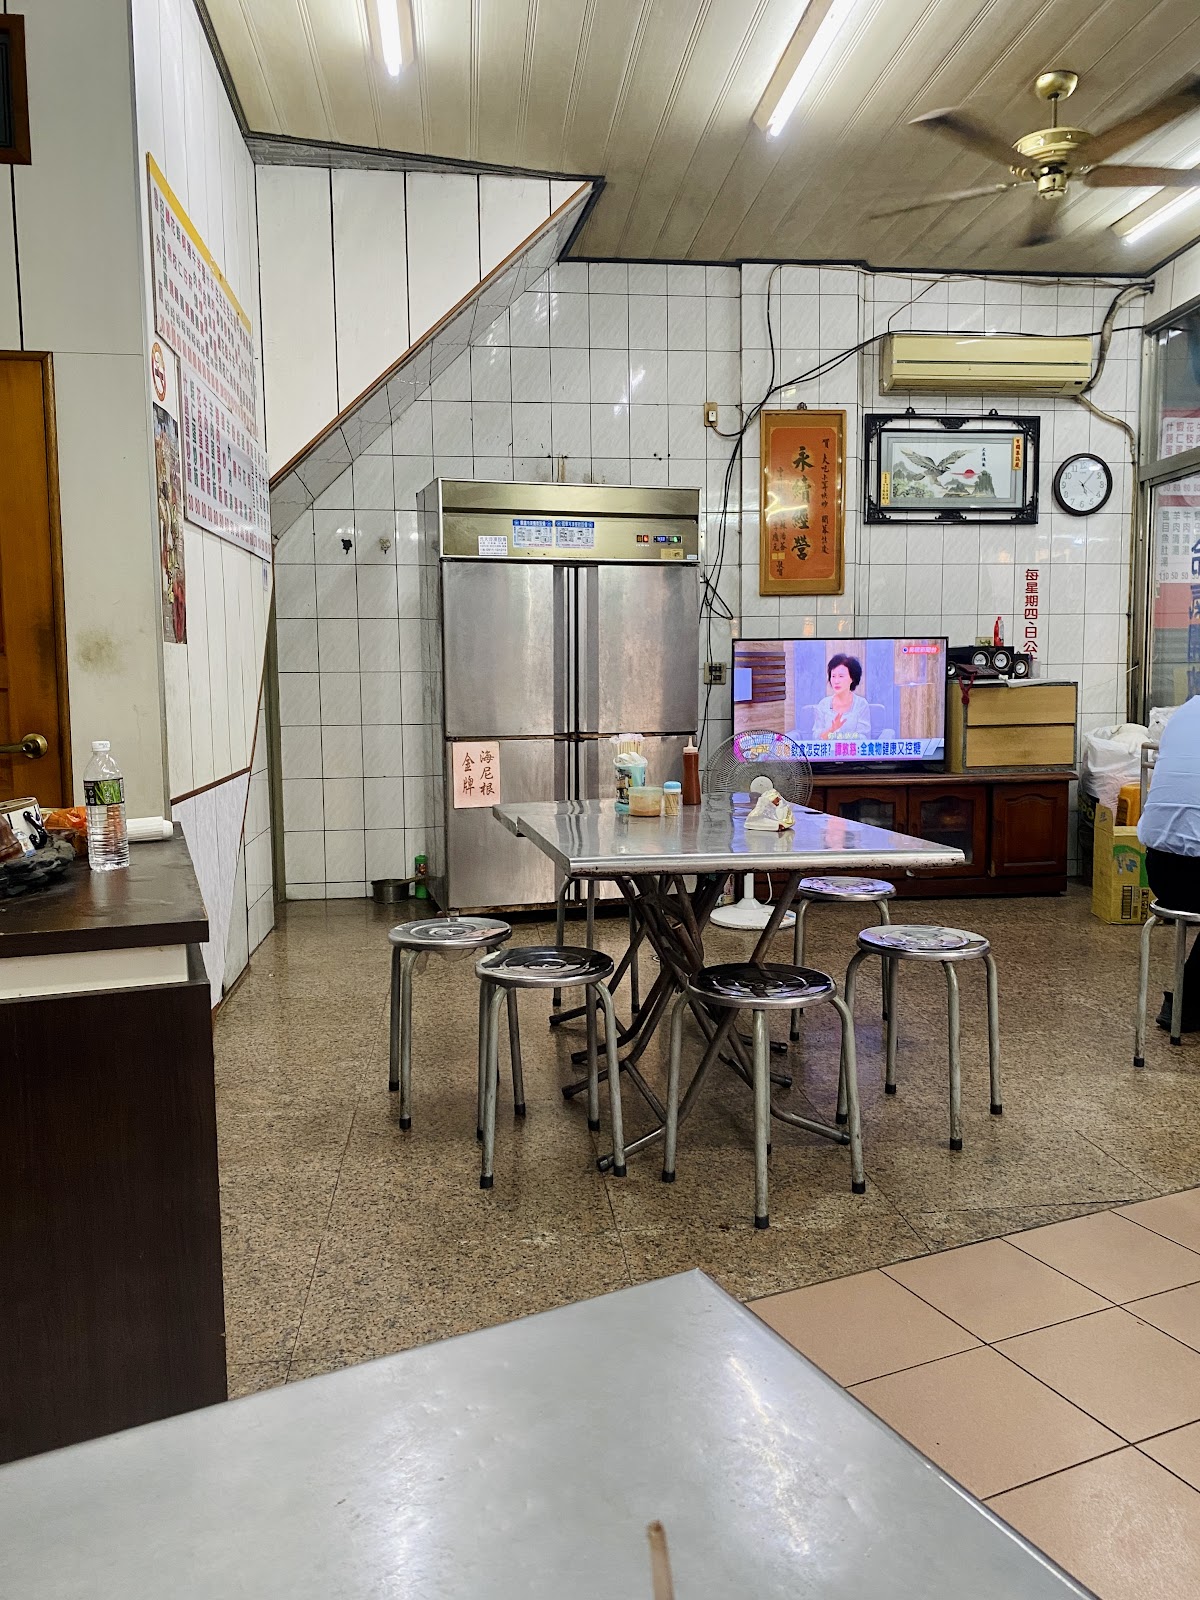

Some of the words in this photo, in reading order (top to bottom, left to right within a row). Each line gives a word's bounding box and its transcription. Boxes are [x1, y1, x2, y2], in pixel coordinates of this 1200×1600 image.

[791, 445, 815, 561] 永續經營
[461, 752, 476, 797] 金牌
[479, 750, 495, 796] 海尼根
